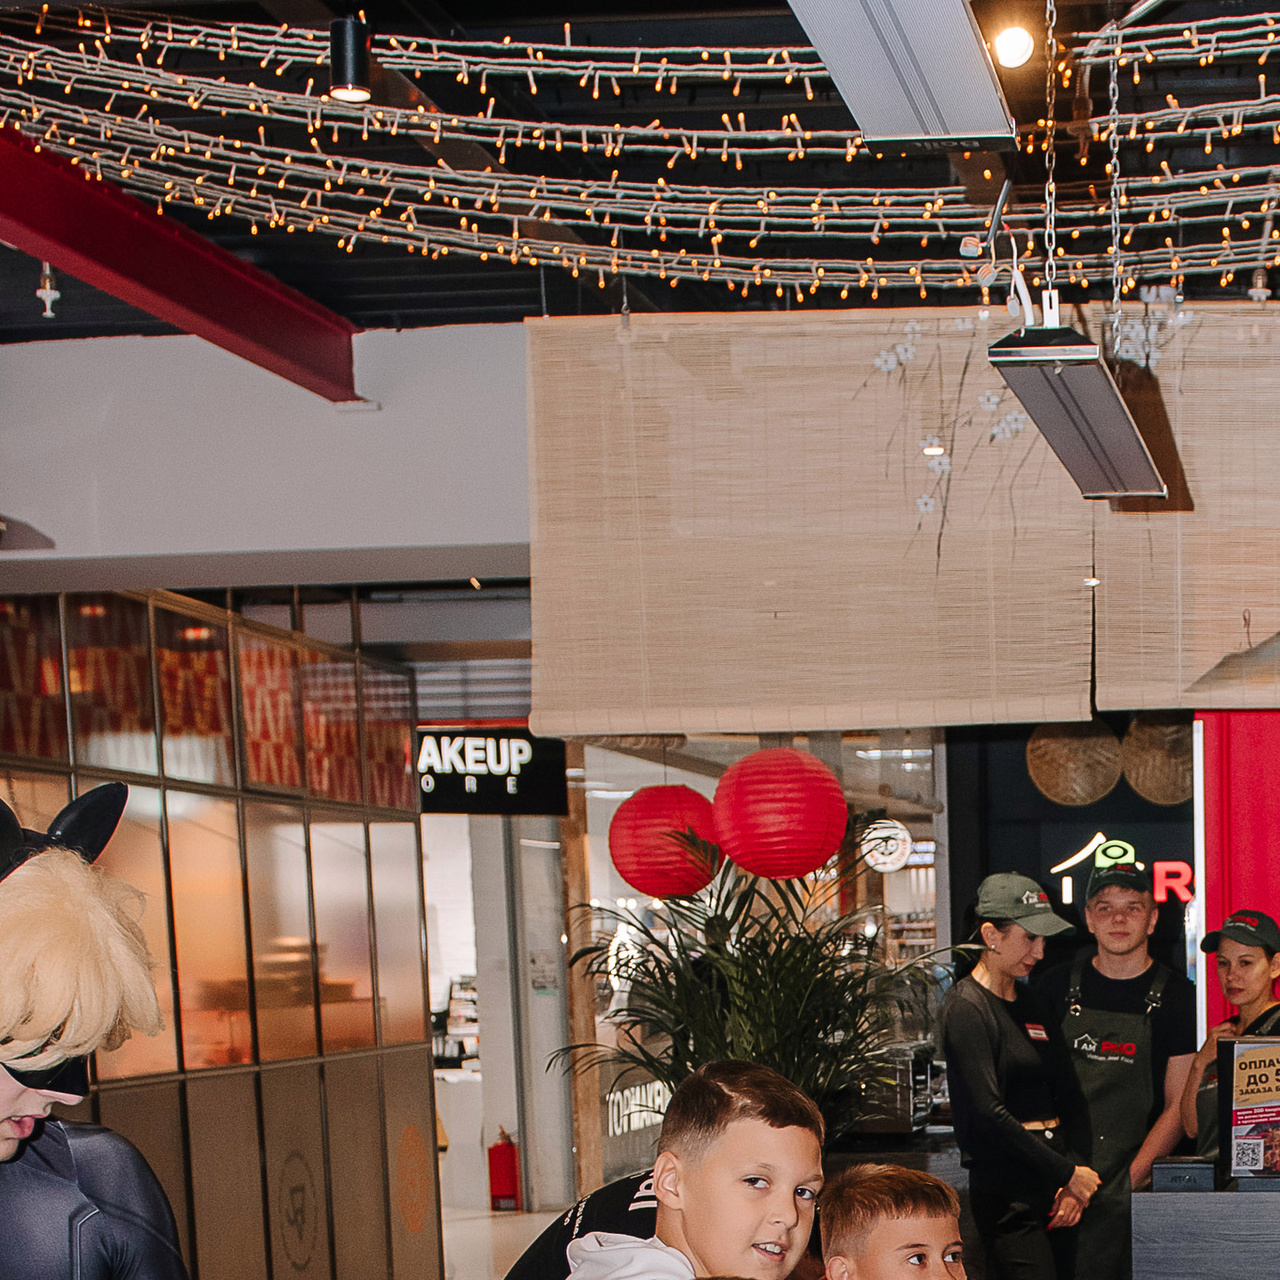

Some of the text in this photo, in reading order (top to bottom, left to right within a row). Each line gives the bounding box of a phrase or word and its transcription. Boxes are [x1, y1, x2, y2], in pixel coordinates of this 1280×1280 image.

[417, 735, 532, 775] AKEUP
[421, 774, 518, 794] ORE
[1153, 861, 1196, 902] R
[1101, 1041, 1137, 1056] PHO
[1246, 1073, 1270, 1088] ДО
[1238, 1086, 1273, 1096] ЗАКАЗА
